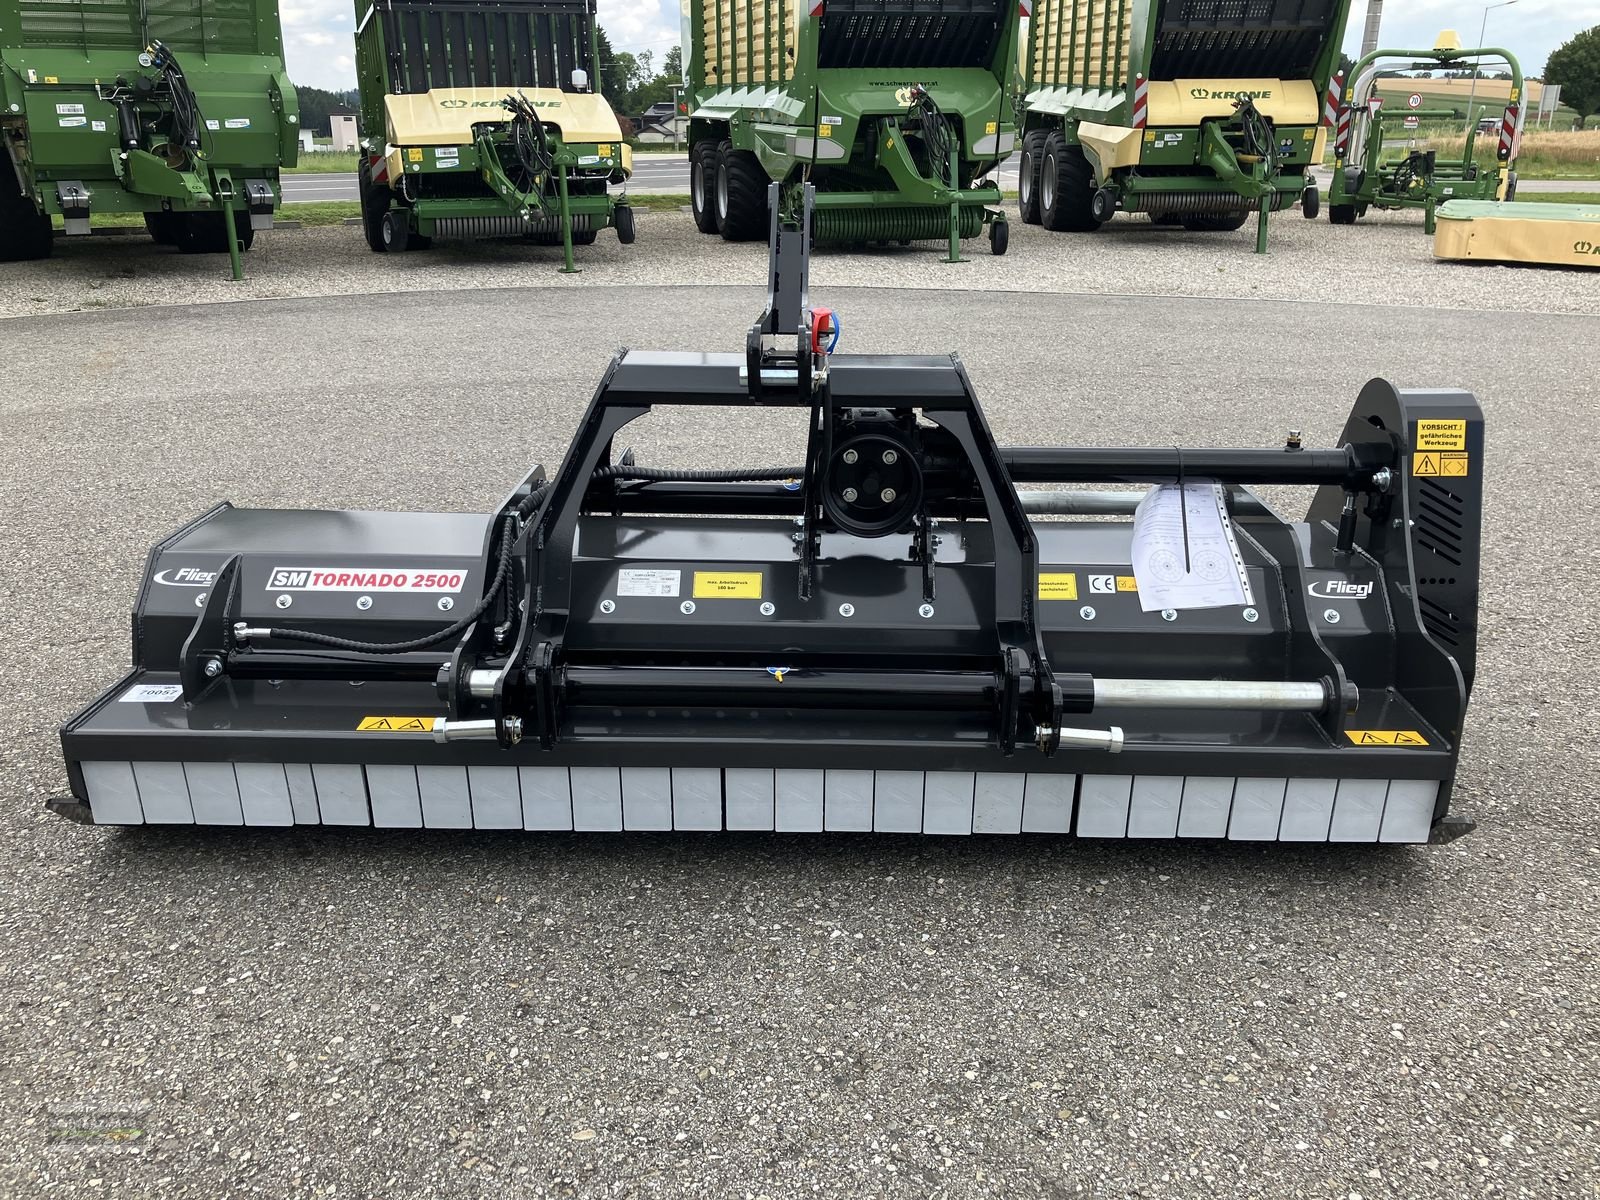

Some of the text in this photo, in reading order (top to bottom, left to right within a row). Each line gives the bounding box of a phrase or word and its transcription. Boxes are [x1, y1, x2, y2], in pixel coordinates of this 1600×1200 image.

[1411, 96, 1419, 104] 70
[174, 567, 217, 585] Flieg
[274, 571, 461, 588] SM TORNADO 2500
[1092, 577, 1112, 590] CE
[1326, 580, 1374, 597] Fliegl
